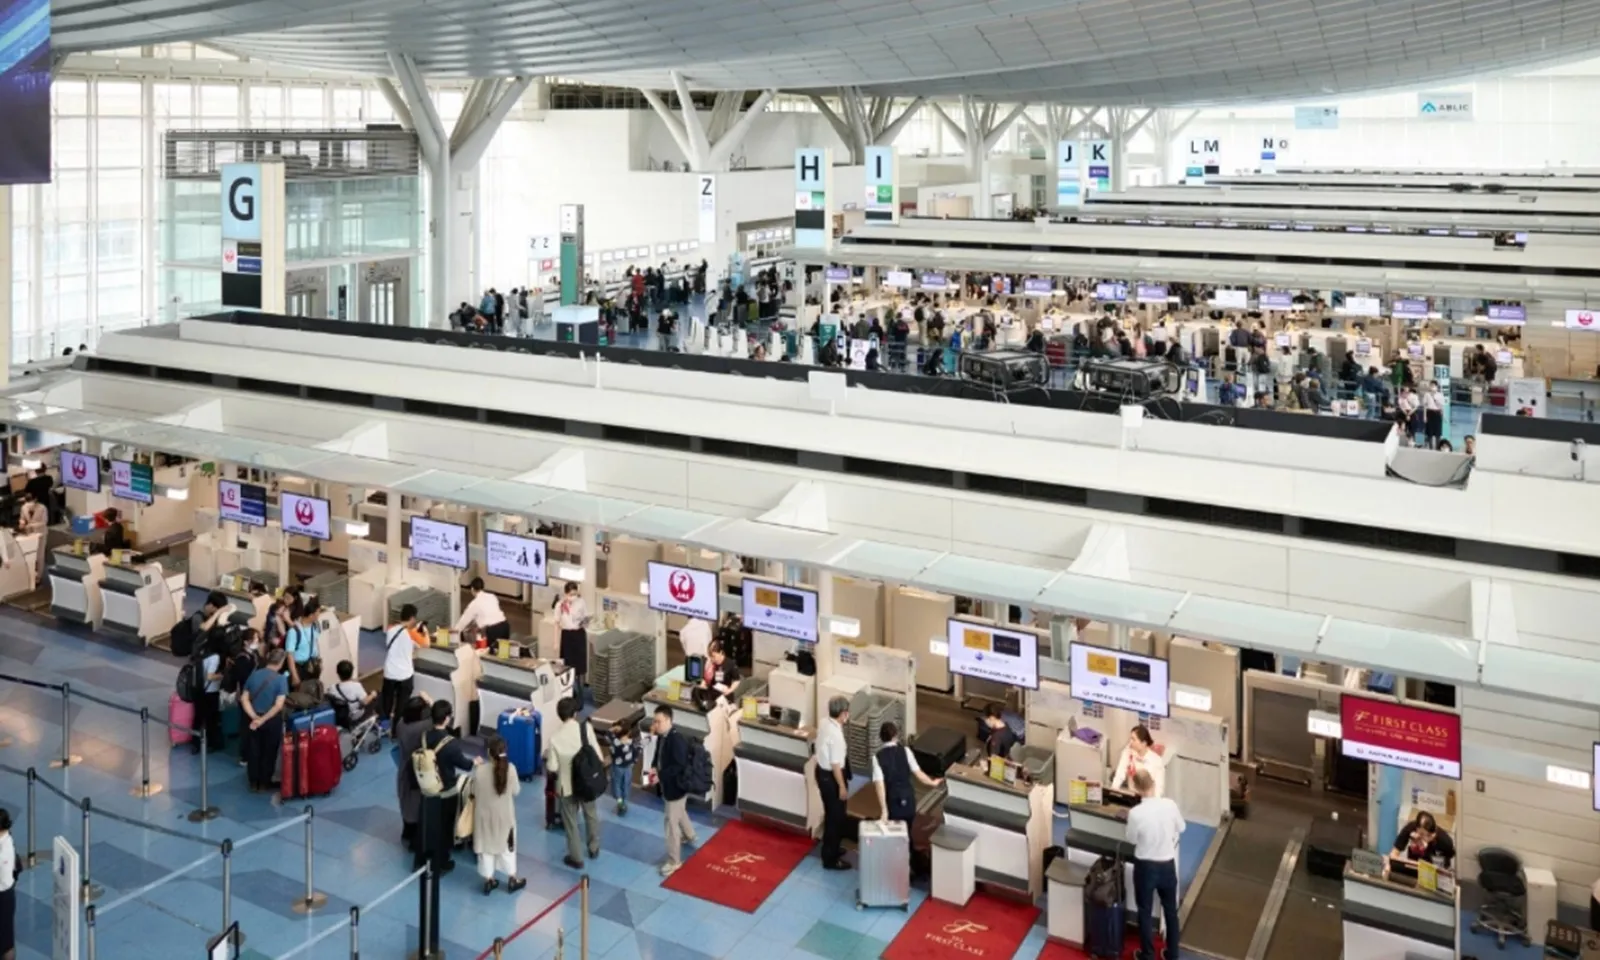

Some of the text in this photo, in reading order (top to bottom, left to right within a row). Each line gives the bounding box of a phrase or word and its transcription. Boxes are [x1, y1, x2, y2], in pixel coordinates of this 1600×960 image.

[1191, 140, 1219, 153] L M
[1263, 138, 1273, 148] N
[1065, 145, 1073, 162] J
[1092, 144, 1106, 160] K
[801, 155, 819, 181] H
[876, 155, 881, 179] I
[702, 178, 712, 195] Z
[229, 177, 254, 221] G
[1372, 714, 1407, 729] FIRST
[1409, 721, 1449, 738] CLASS
